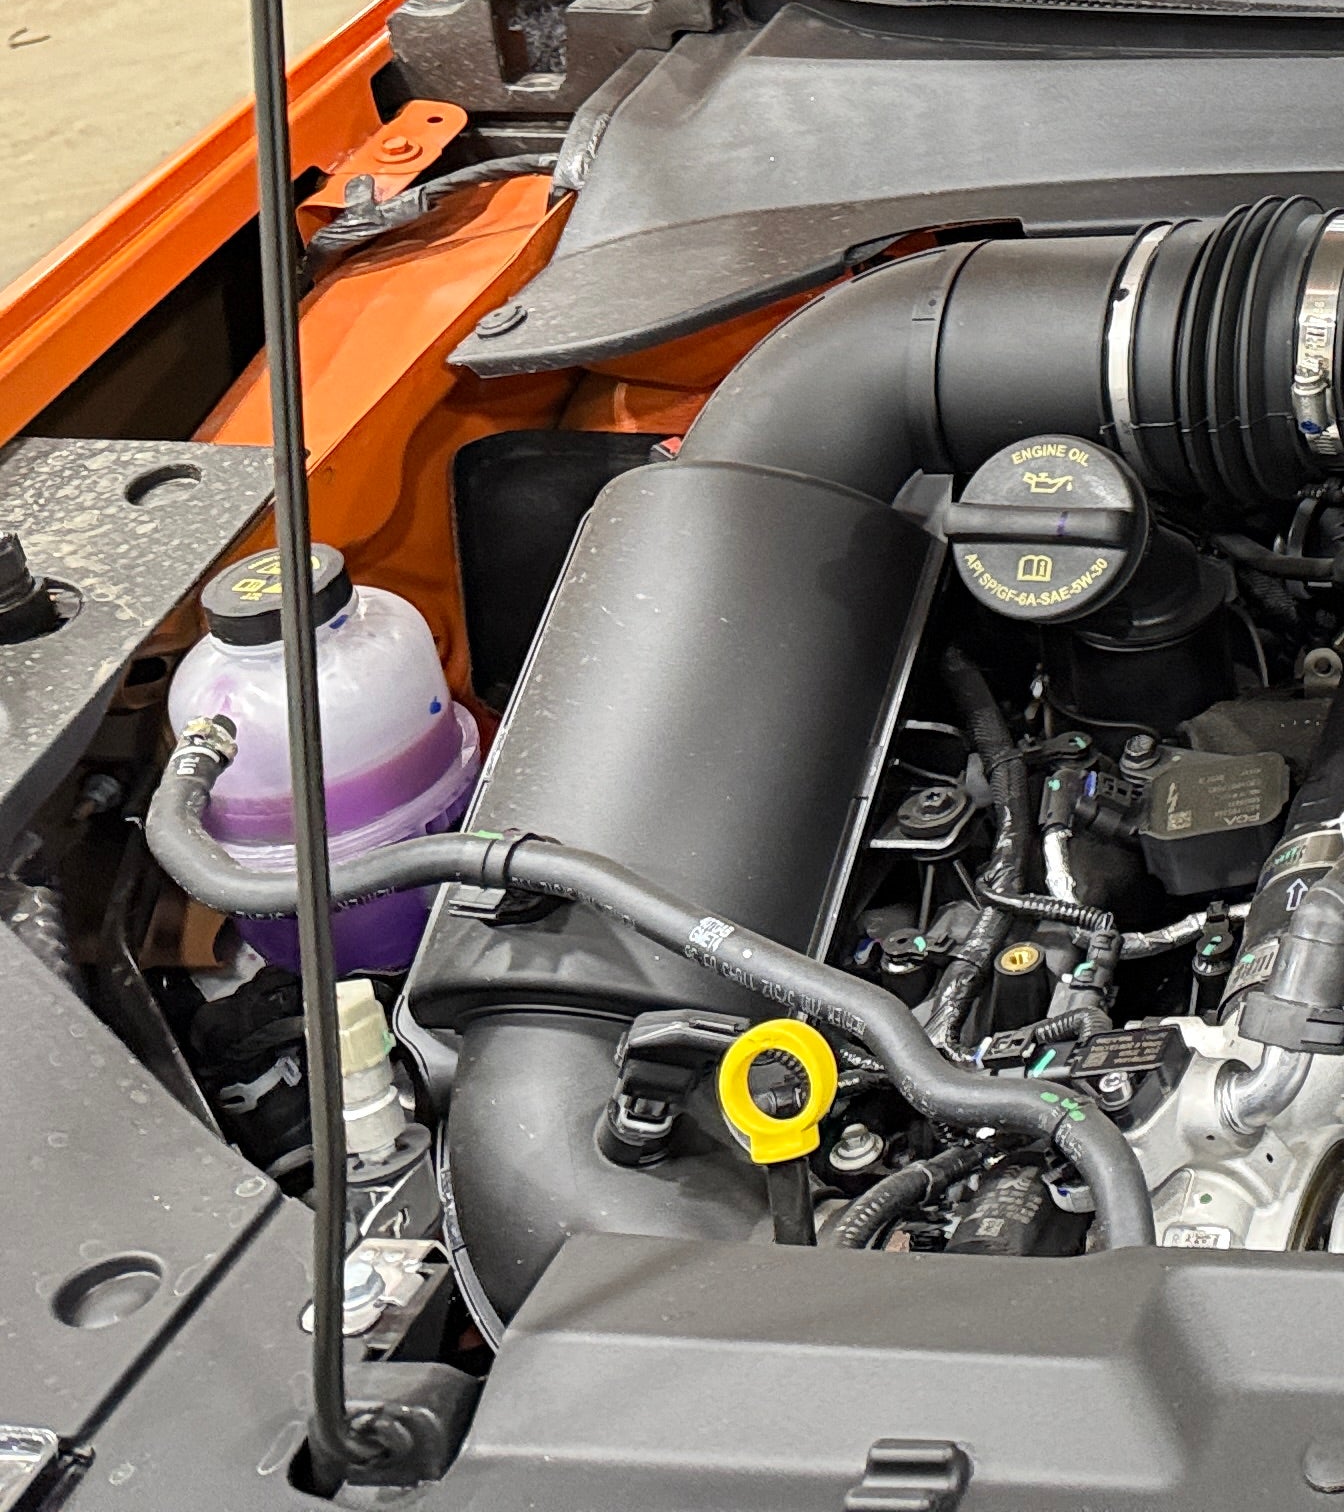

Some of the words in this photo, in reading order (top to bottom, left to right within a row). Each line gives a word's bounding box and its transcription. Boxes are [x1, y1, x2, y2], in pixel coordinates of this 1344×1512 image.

[1011, 444, 1067, 465] ENGINE
[1068, 448, 1090, 467] OIL
[965, 553, 985, 578] API
[1223, 812, 1260, 825] FCA
